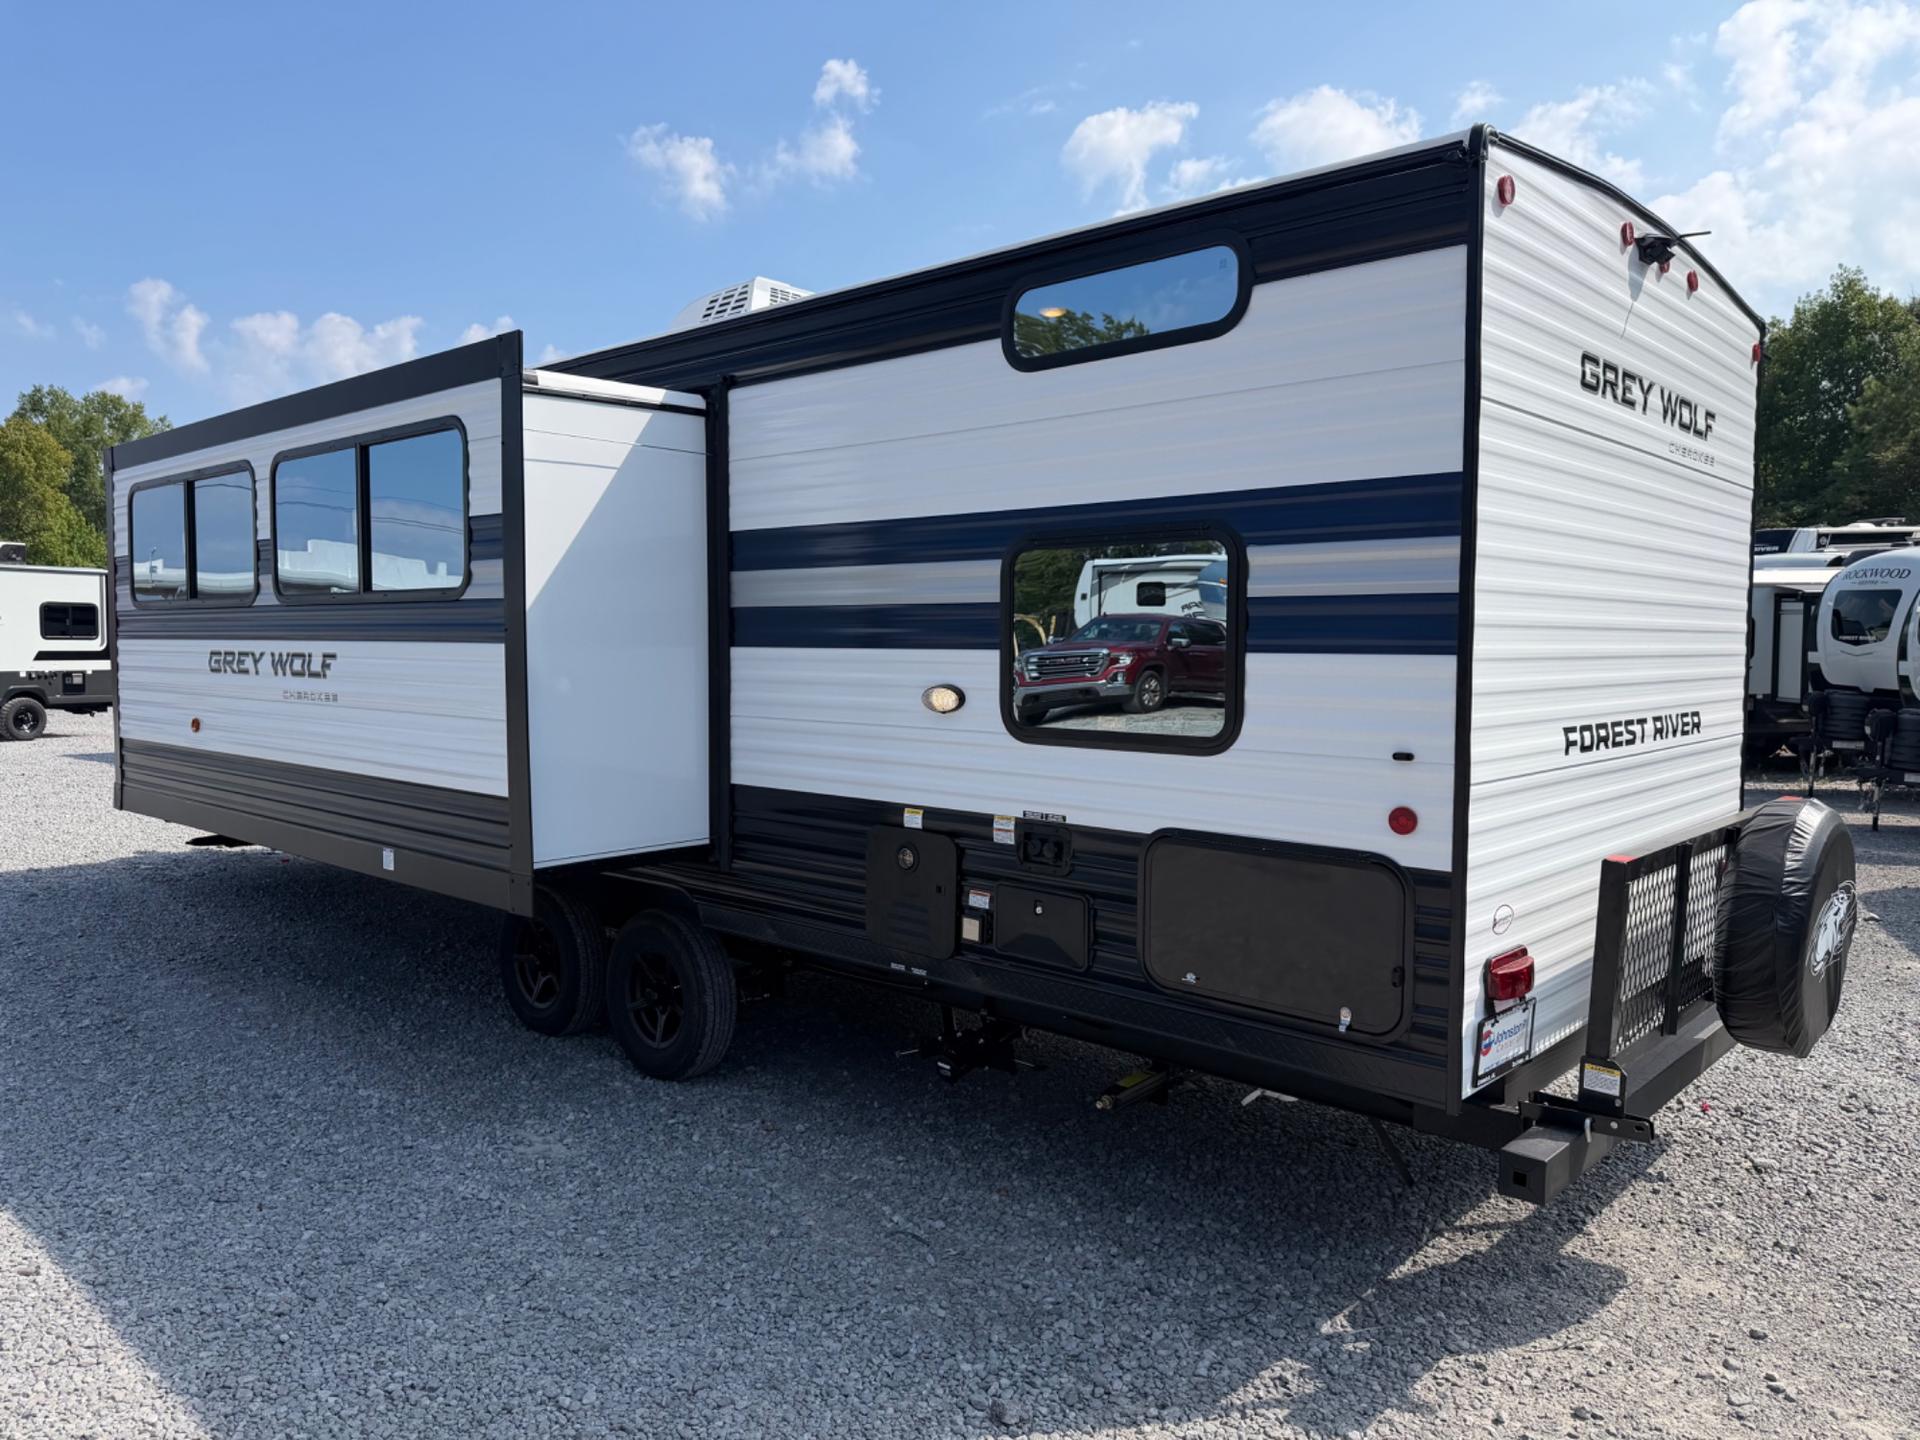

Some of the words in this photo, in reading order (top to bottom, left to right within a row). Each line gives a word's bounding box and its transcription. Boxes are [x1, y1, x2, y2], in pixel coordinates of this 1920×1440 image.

[1580, 350, 1655, 415] GREY
[1660, 385, 1716, 441] WOLF
[1843, 568, 1911, 580] ROCKWOOD
[208, 650, 265, 676] GREY
[270, 651, 337, 680] WOLF
[1562, 717, 1648, 756] FOREST
[1652, 710, 1701, 742] RIVER
